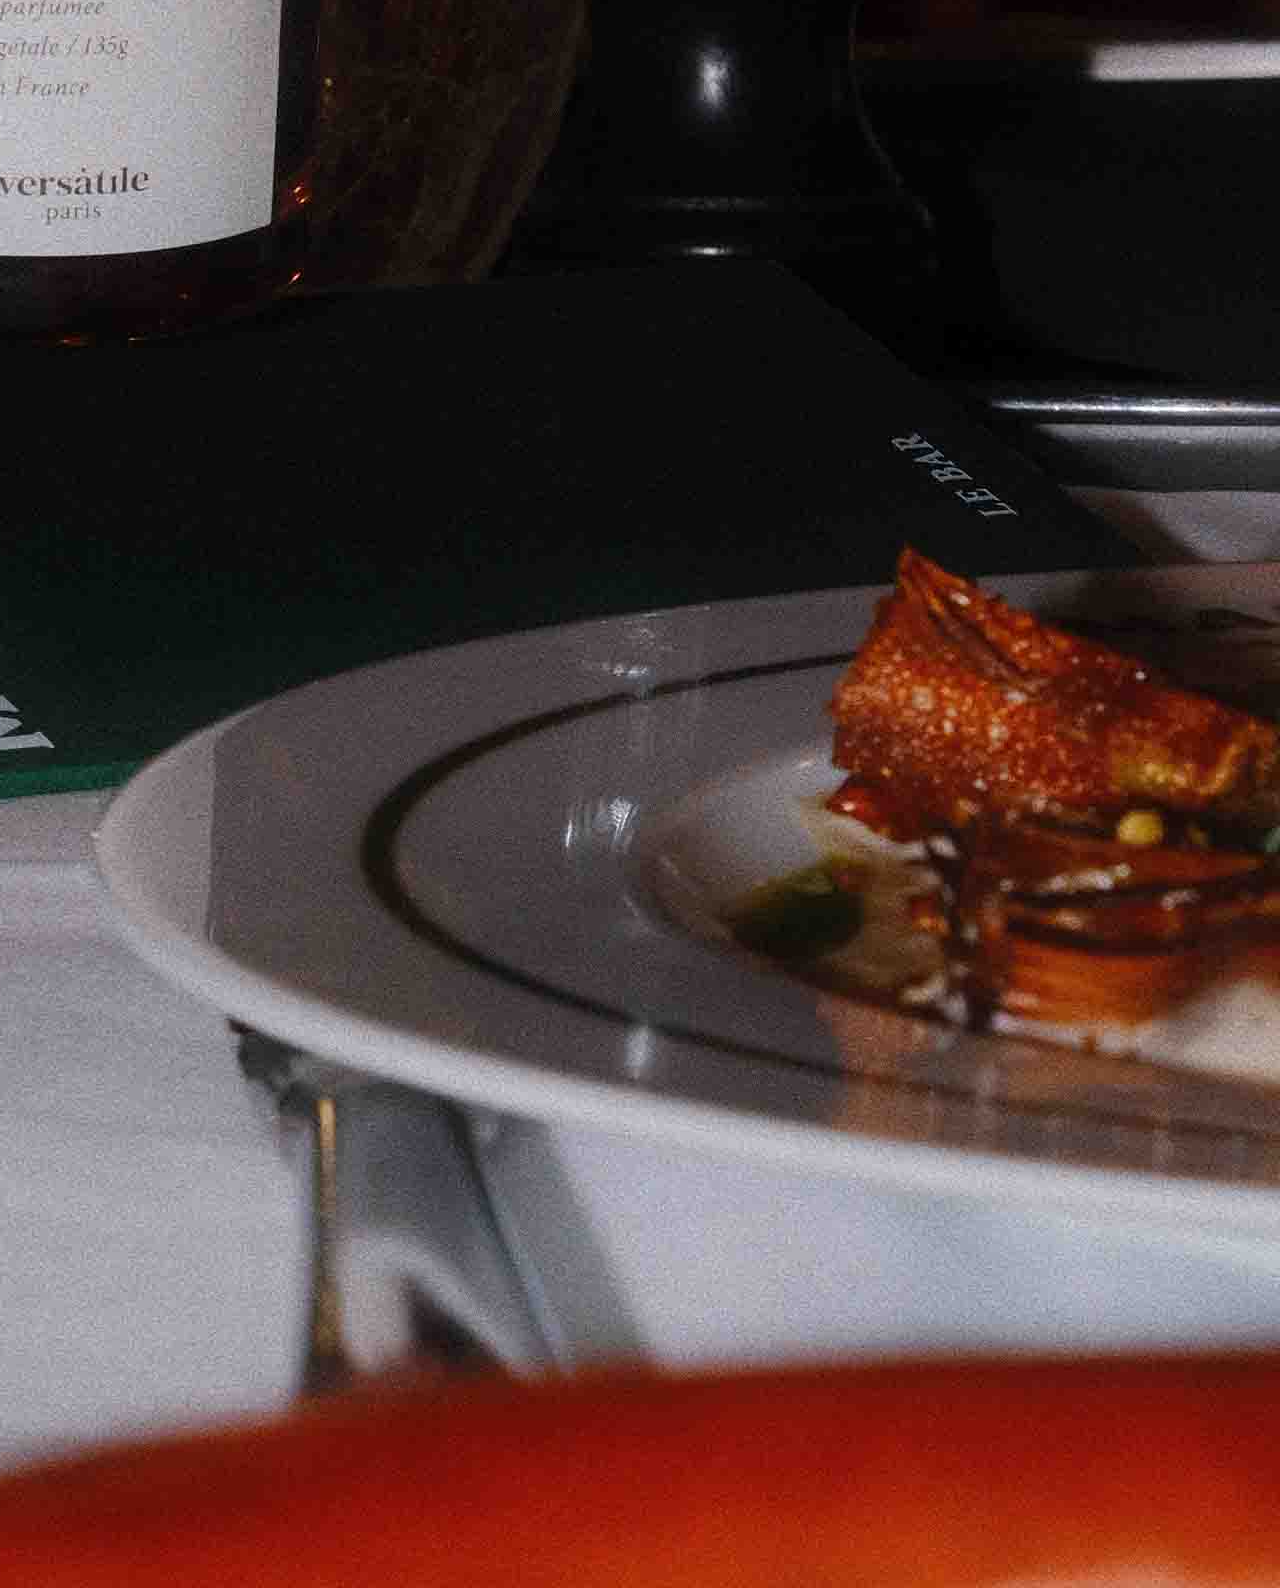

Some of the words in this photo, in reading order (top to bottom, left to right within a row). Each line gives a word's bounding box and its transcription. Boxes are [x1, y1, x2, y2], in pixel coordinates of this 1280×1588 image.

[64, 32, 81, 56] /
[83, 34, 130, 60] 135g
[15, 75, 92, 97] France
[45, 201, 103, 226] paris
[891, 433, 974, 483] BAR
[953, 487, 1018, 517] LE
